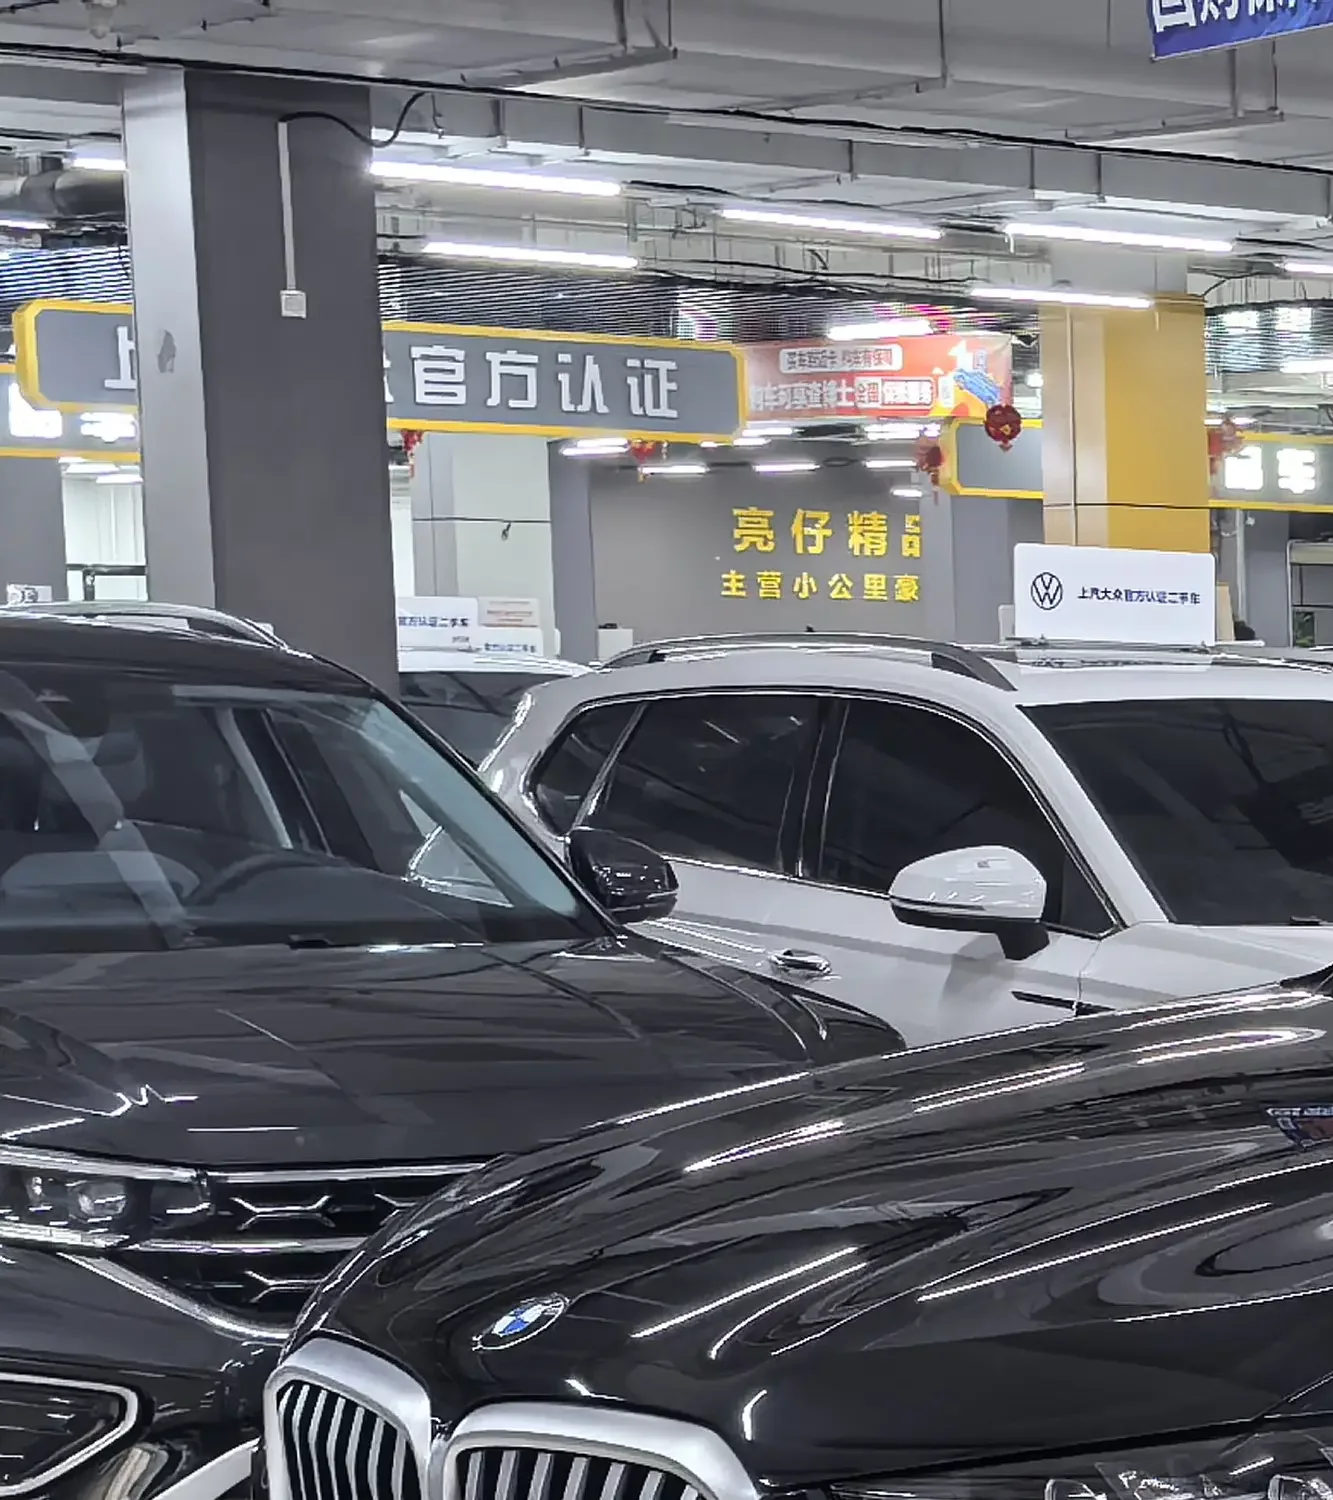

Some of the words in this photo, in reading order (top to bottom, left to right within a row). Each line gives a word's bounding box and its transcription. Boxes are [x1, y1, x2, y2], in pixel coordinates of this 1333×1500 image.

[1077, 586, 1201, 605] 上汽大众官方认证二手车
